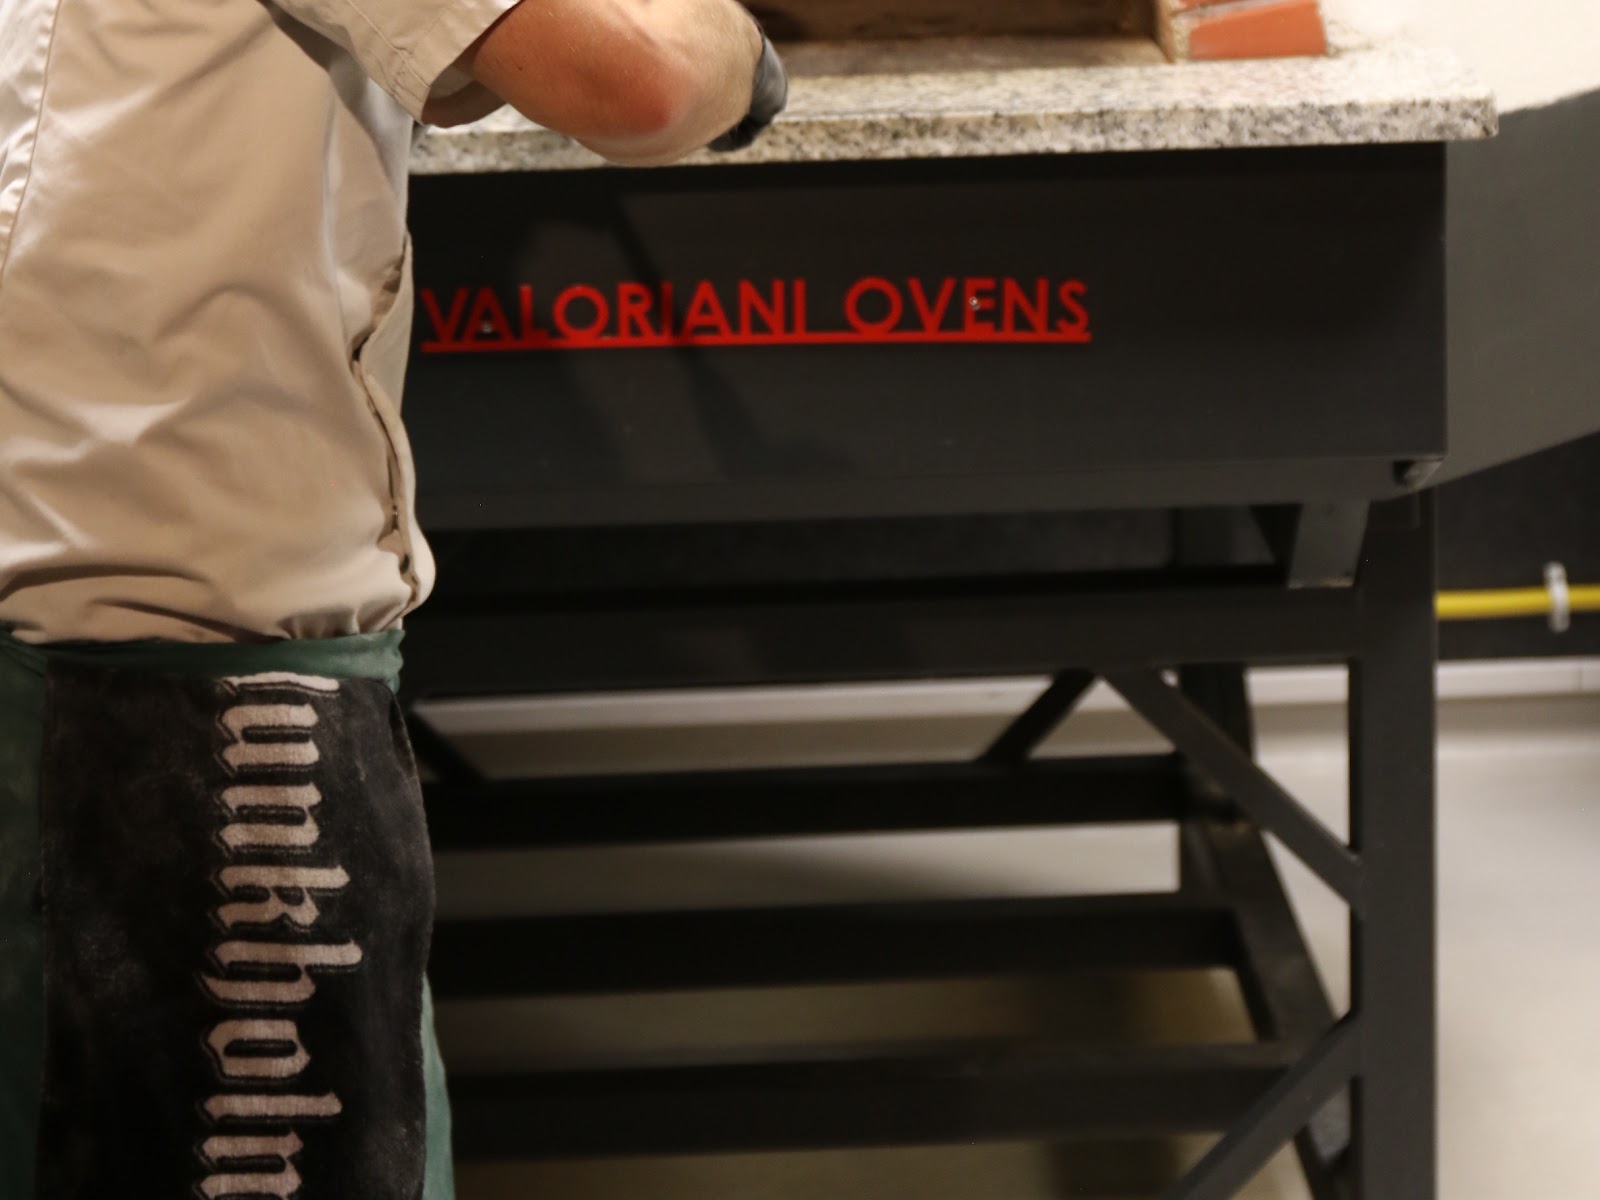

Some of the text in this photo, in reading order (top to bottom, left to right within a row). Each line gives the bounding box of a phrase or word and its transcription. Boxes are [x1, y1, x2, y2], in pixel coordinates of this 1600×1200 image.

[420, 277, 1091, 346] VALORIANI OVENS
[196, 672, 362, 1200] unkholm
